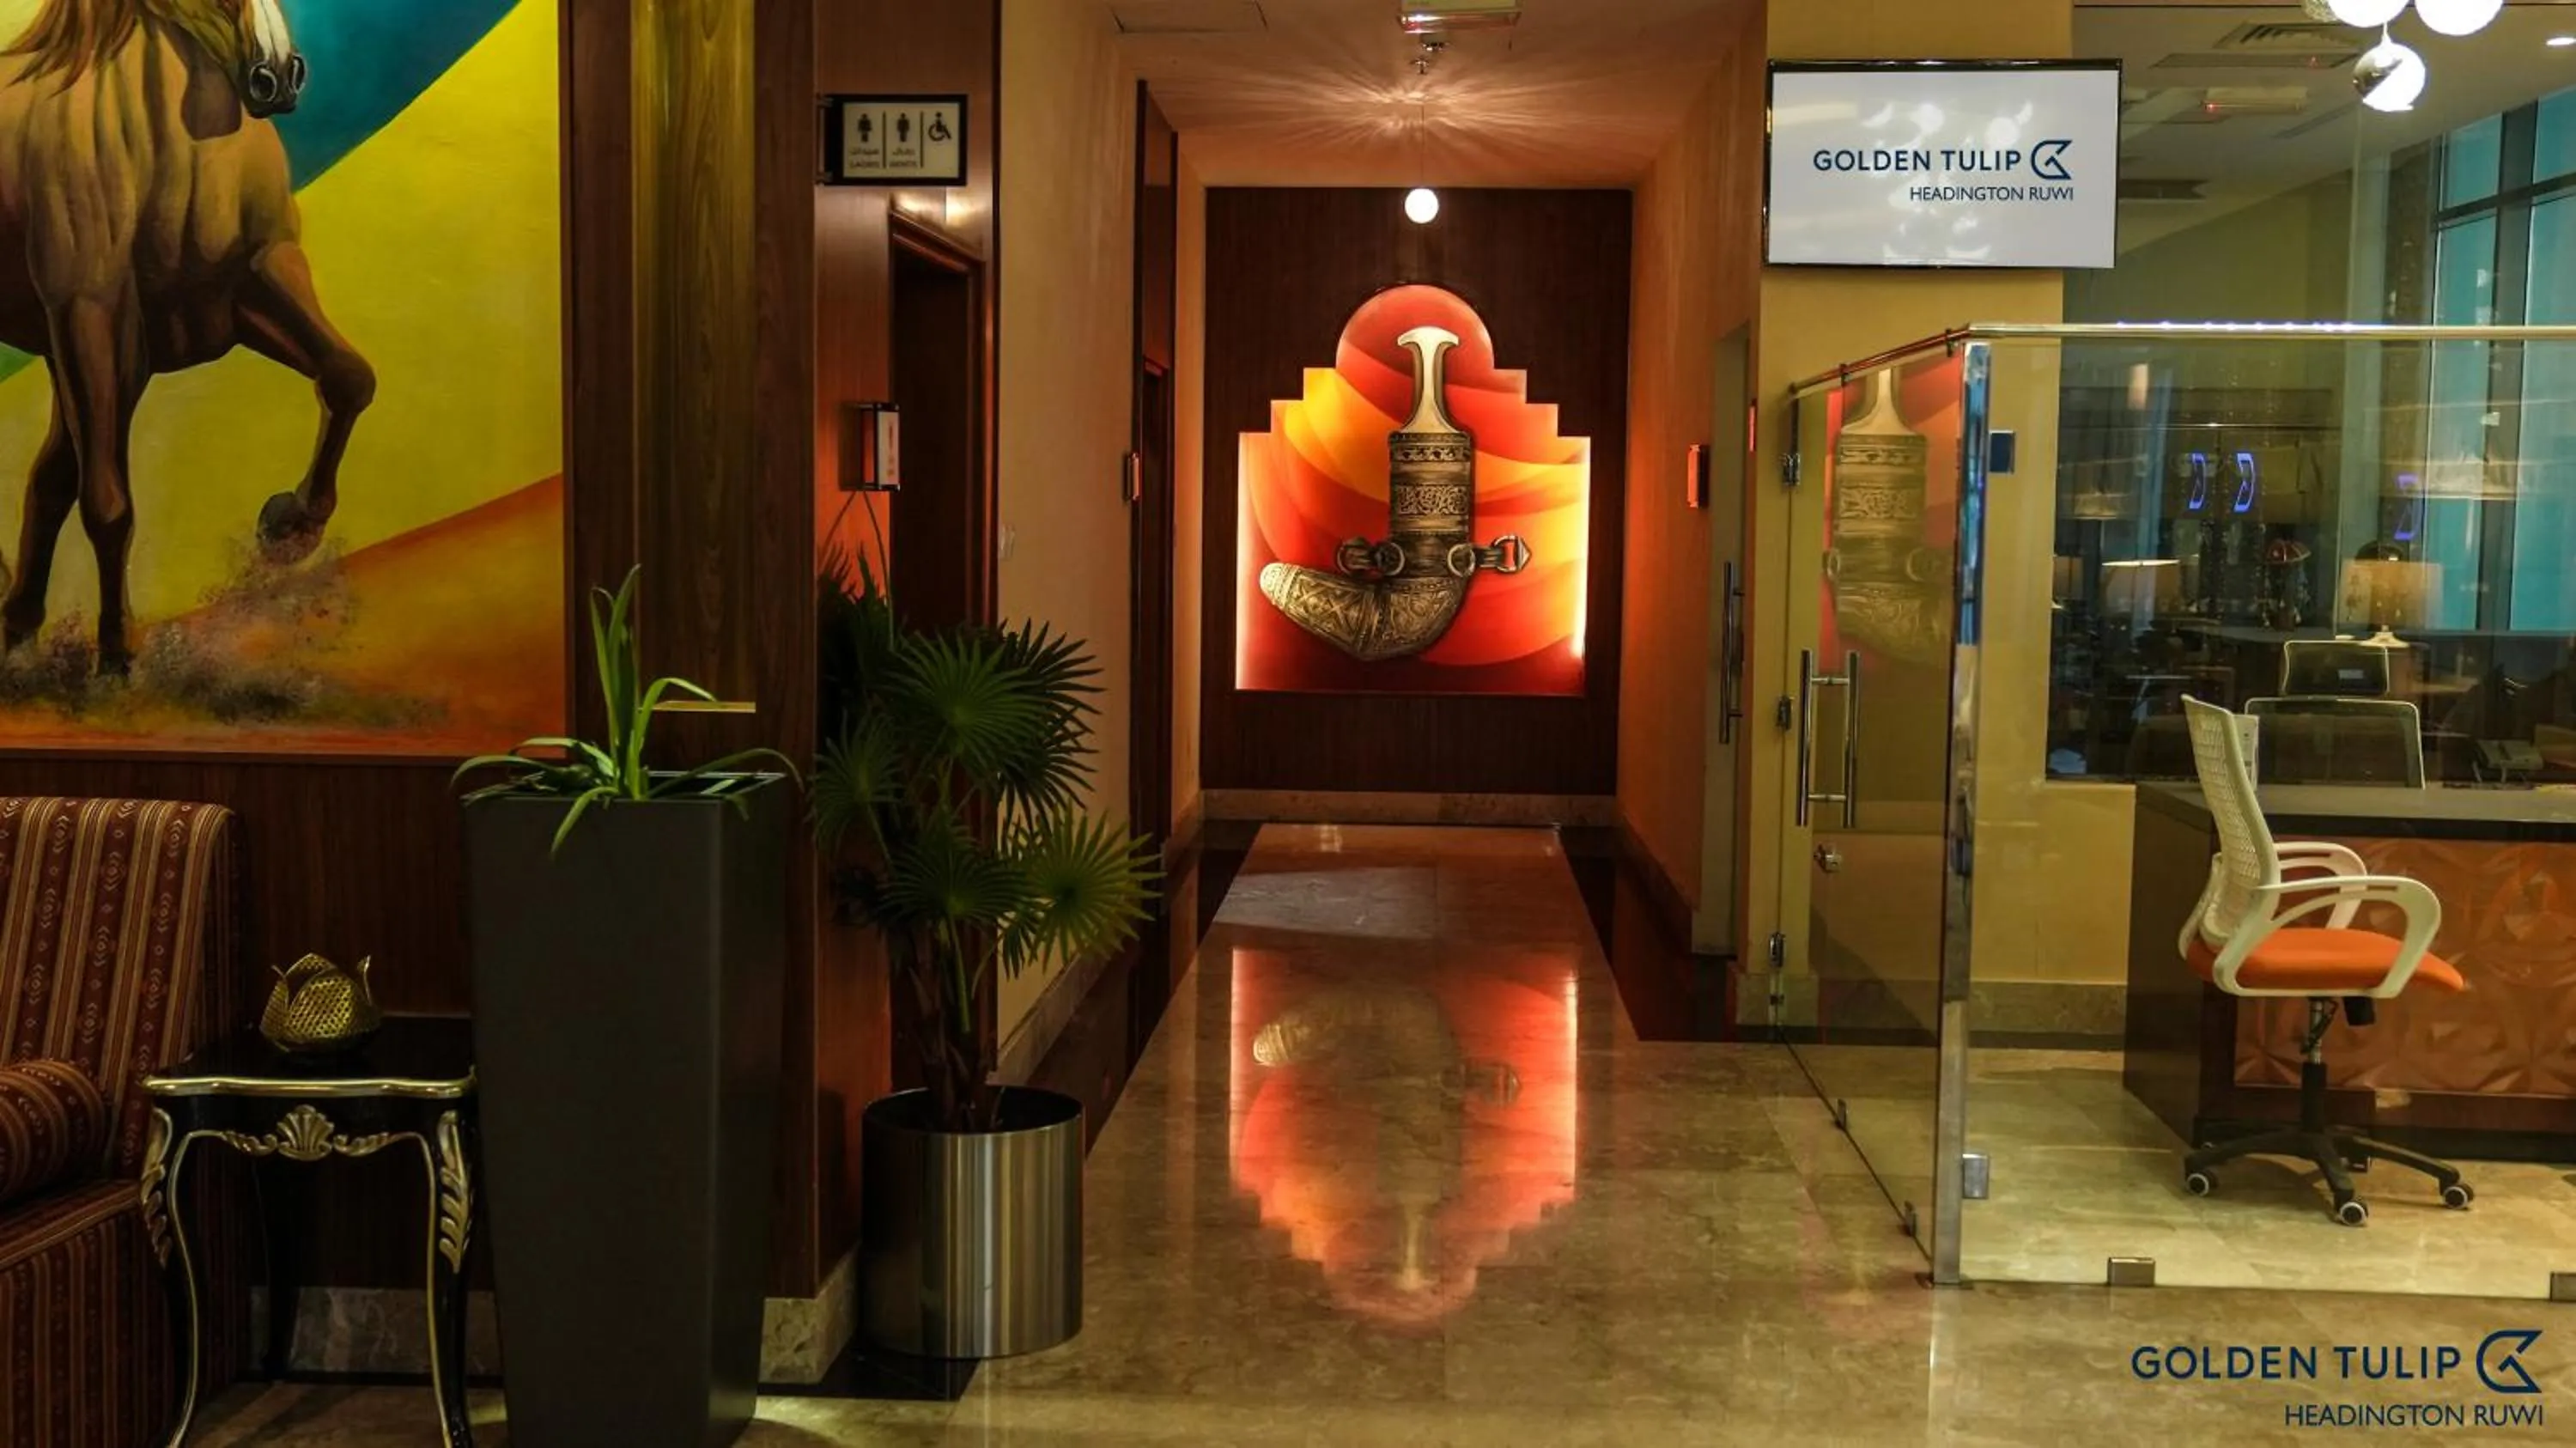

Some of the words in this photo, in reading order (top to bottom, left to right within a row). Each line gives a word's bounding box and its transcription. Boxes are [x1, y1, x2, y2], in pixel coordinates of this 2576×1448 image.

[1813, 149, 1931, 172] GOLDEN
[1940, 149, 2022, 172] TULIP
[1910, 186, 2024, 201] HEADINGTON
[2029, 186, 2074, 201] RUWI
